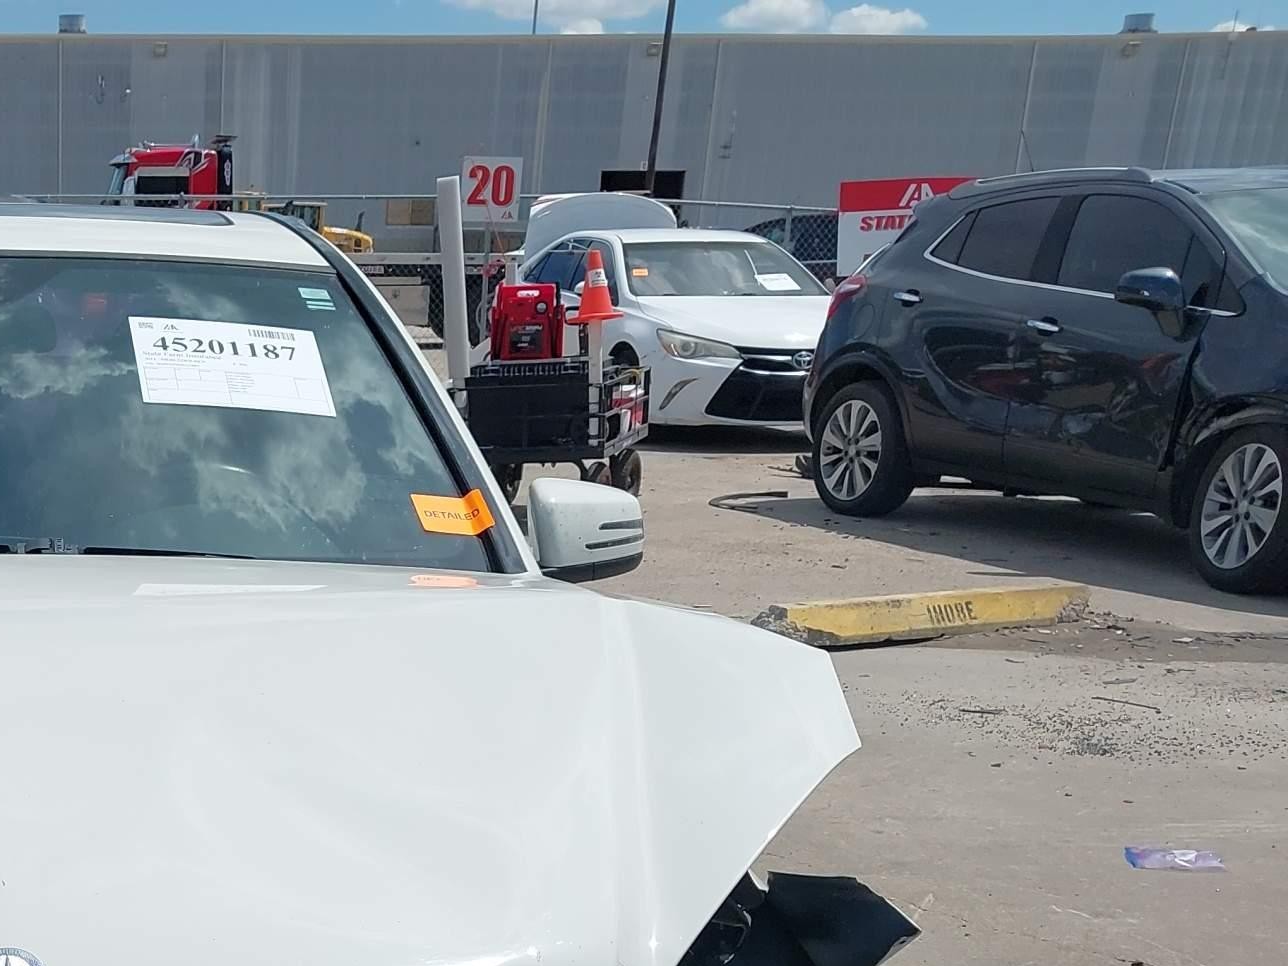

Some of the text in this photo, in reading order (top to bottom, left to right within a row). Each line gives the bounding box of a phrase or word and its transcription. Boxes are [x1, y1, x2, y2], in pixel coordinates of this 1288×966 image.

[466, 164, 515, 207] 20
[152, 336, 296, 361] 45201187
[423, 508, 480, 521] DETAILED
